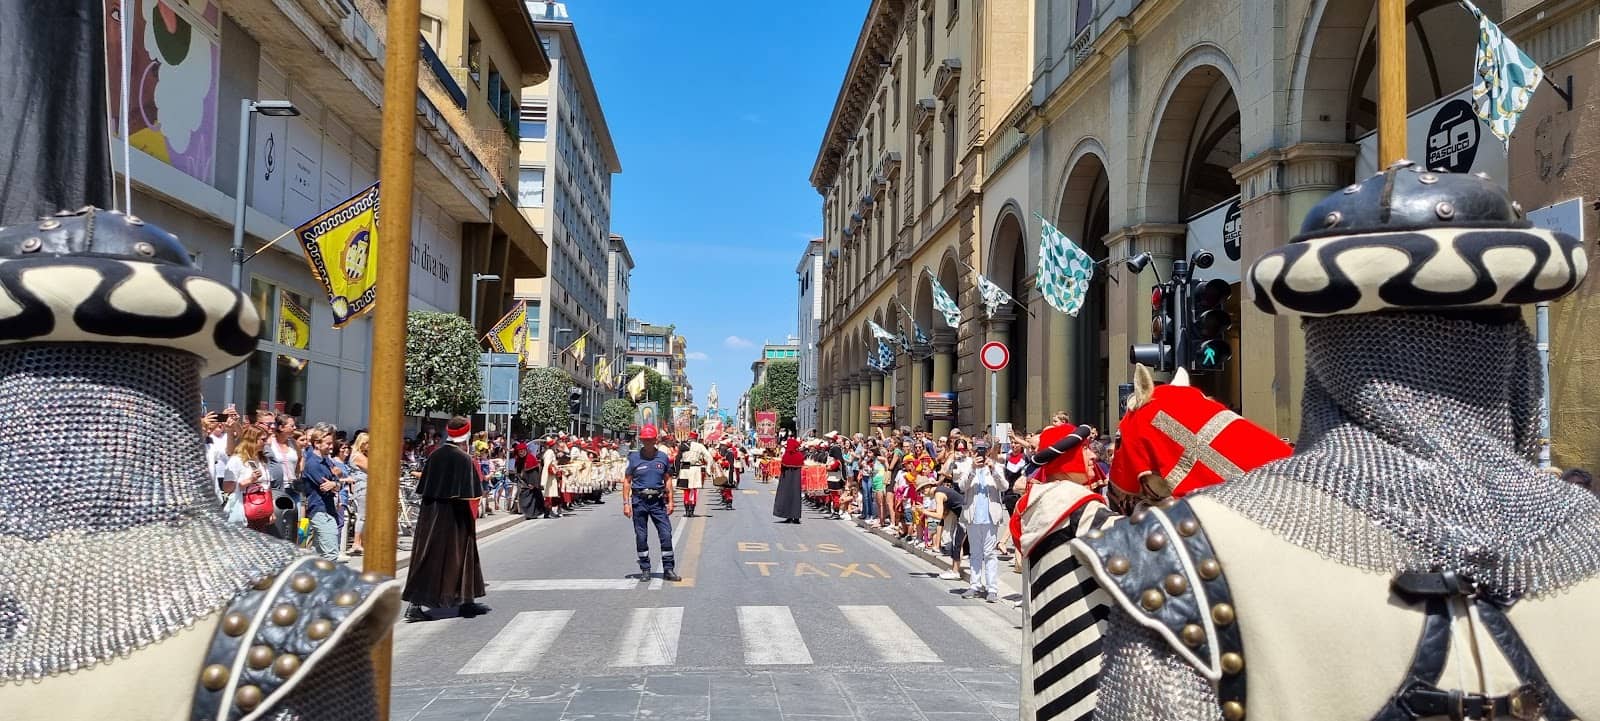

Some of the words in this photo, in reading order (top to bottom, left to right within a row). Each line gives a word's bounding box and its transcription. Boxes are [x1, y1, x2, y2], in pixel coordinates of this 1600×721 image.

[1430, 139, 1470, 162] PASCUCCI
[737, 542, 845, 553] BUS
[744, 561, 893, 578] TAXI
